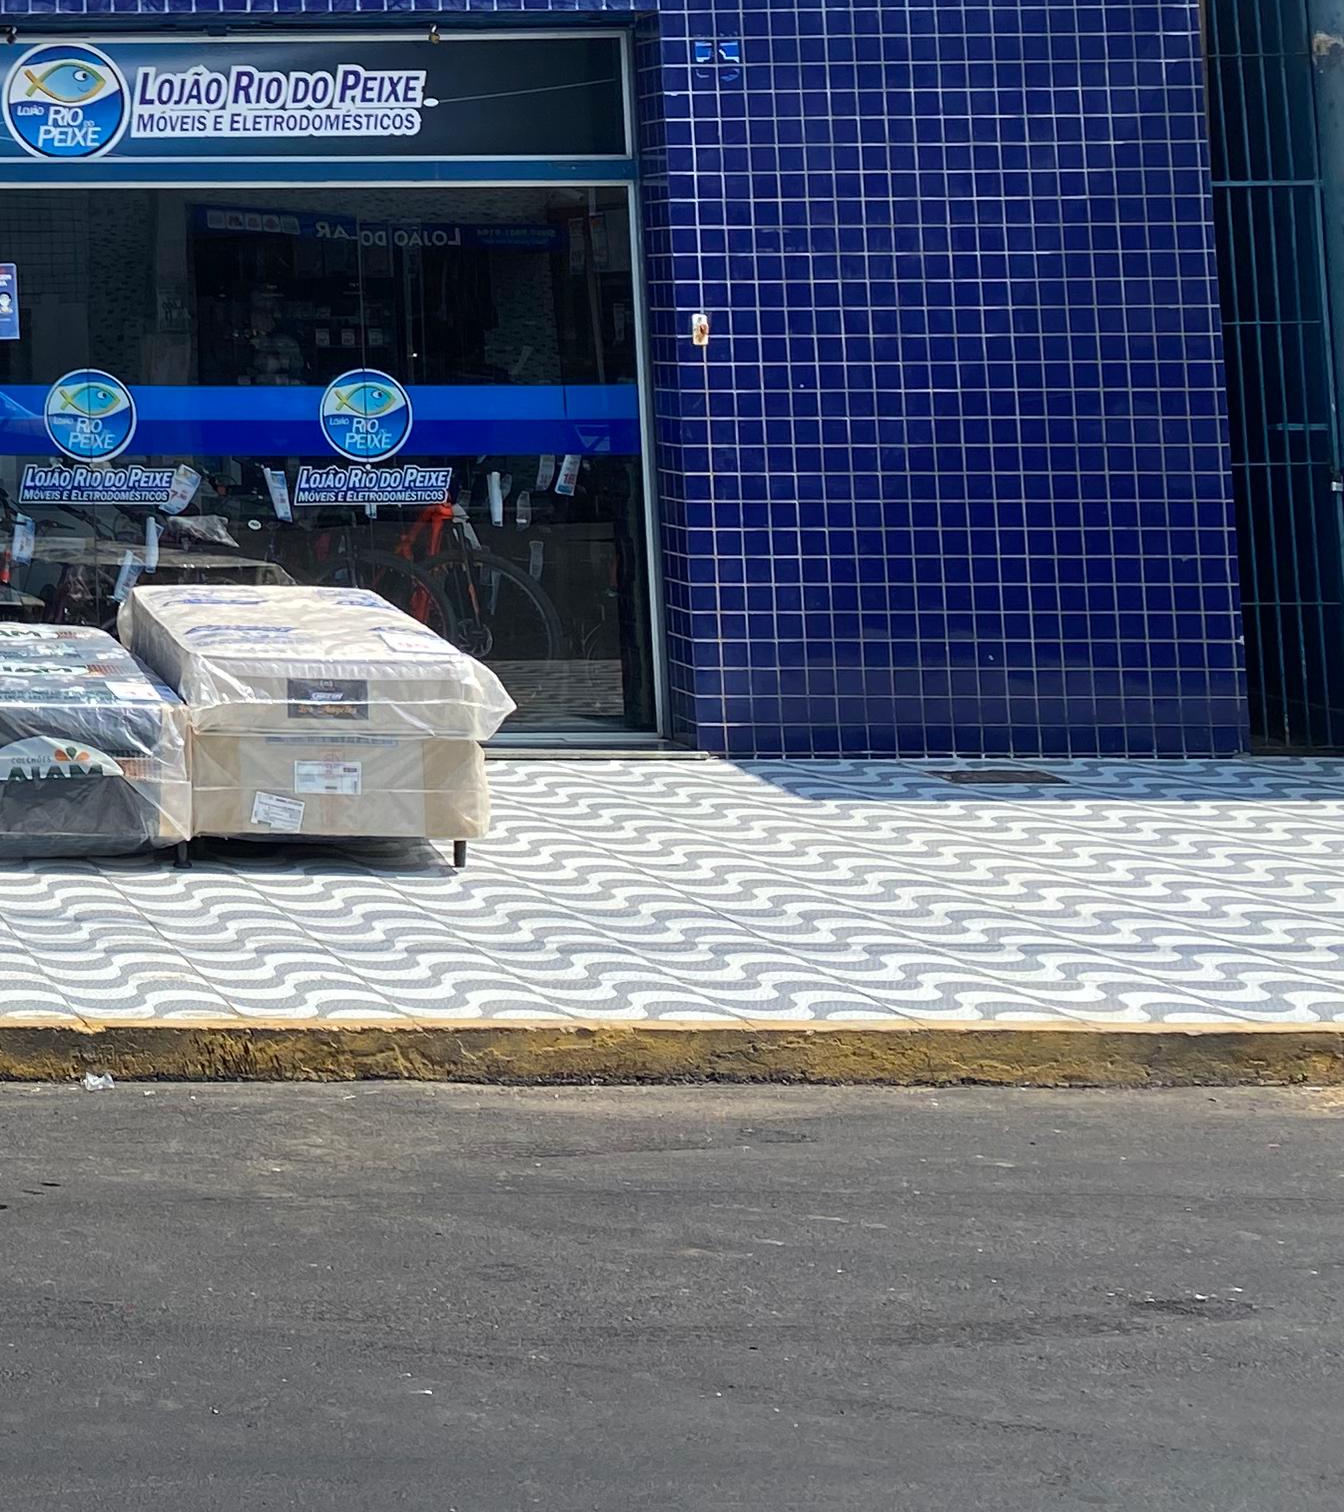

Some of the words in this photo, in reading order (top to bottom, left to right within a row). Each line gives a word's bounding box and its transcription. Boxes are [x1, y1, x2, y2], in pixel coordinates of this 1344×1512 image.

[139, 71, 221, 106] LOJÃO
[231, 69, 282, 105] RIO
[291, 75, 329, 104] DO
[338, 68, 421, 104] PEIXE
[47, 106, 84, 126] RIO
[136, 110, 208, 133] MÓVEIS
[213, 115, 224, 131] E
[229, 109, 416, 132] ELETRODOMÉSTICOS
[38, 125, 102, 148] PEIXE
[76, 418, 103, 433] RIO
[351, 418, 379, 433] RIO
[68, 433, 116, 449] PEIXE
[345, 432, 393, 449] PEIXE
[25, 467, 71, 487] LOJÃO
[74, 467, 101, 487] RIO
[104, 470, 125, 487] DO
[128, 467, 173, 487] PEIXE
[300, 468, 346, 488] LOJÃO
[348, 468, 377, 488] RIO
[379, 471, 401, 487] DO
[404, 468, 449, 487] PEIXE
